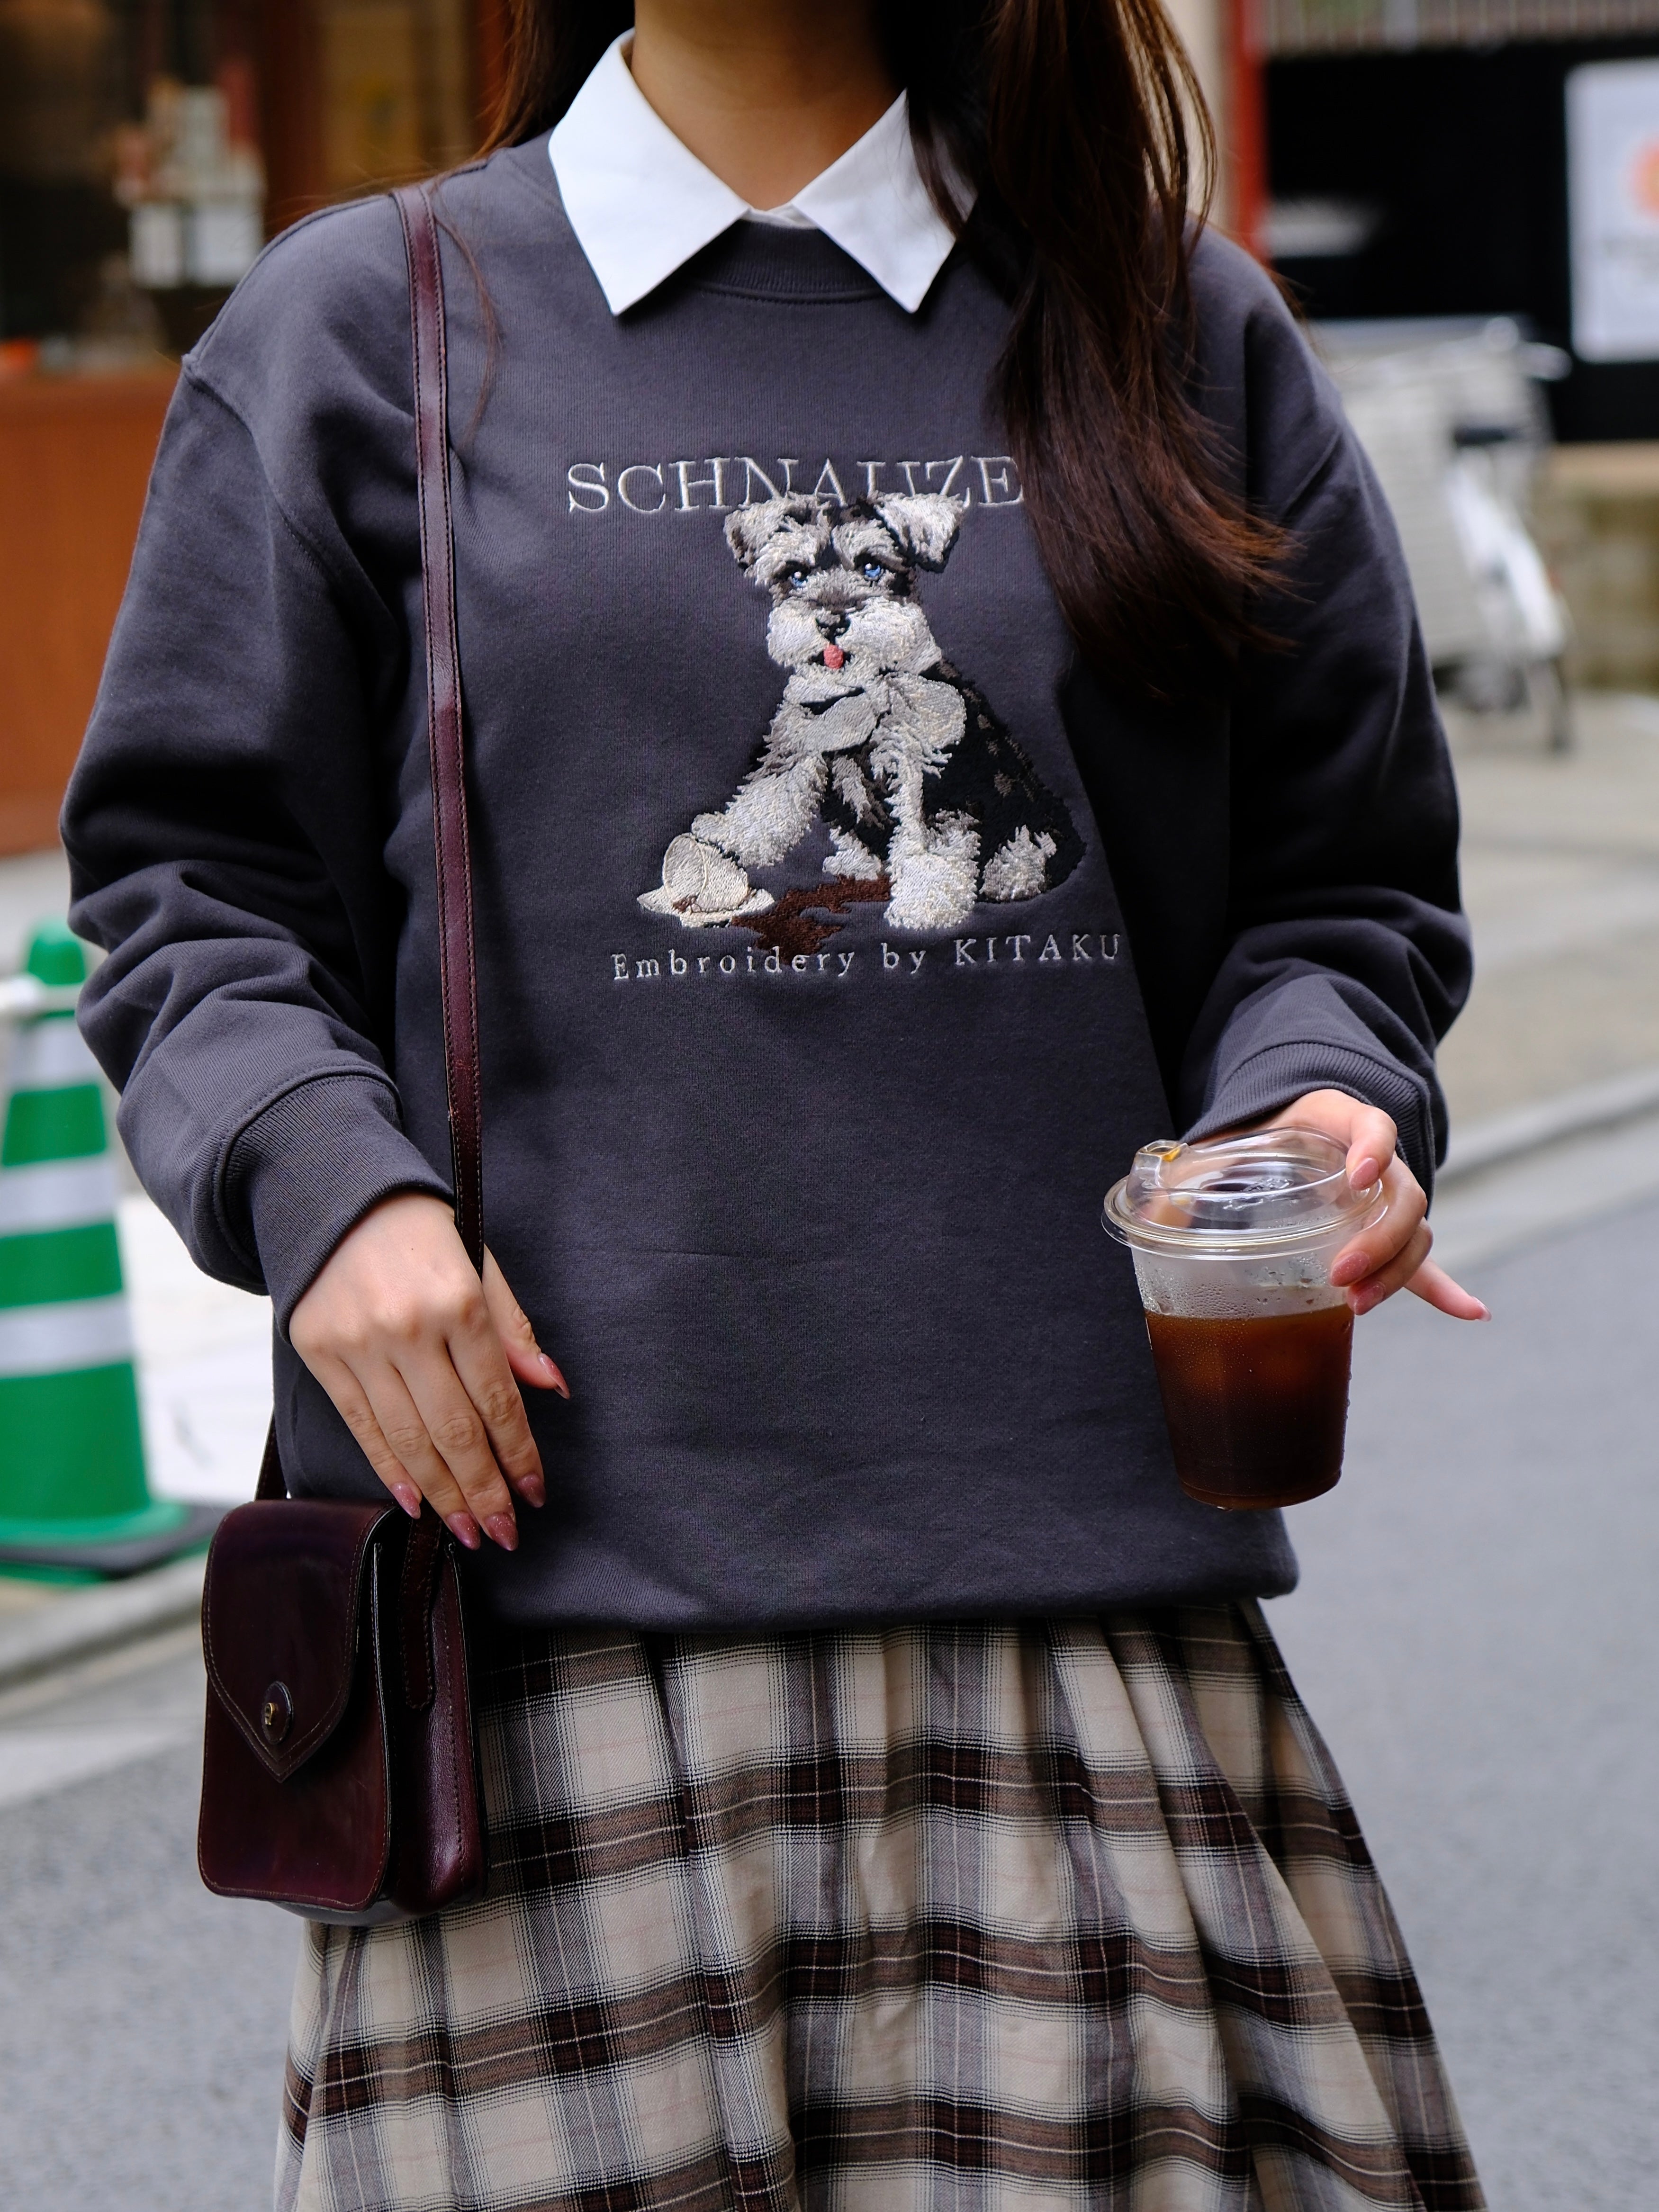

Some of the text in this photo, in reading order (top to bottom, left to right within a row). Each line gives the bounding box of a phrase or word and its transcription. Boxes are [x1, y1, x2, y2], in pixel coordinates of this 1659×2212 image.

[568, 455, 1025, 514] SCHNAUZE
[610, 934, 1121, 980] Embroidery by KITAKU
